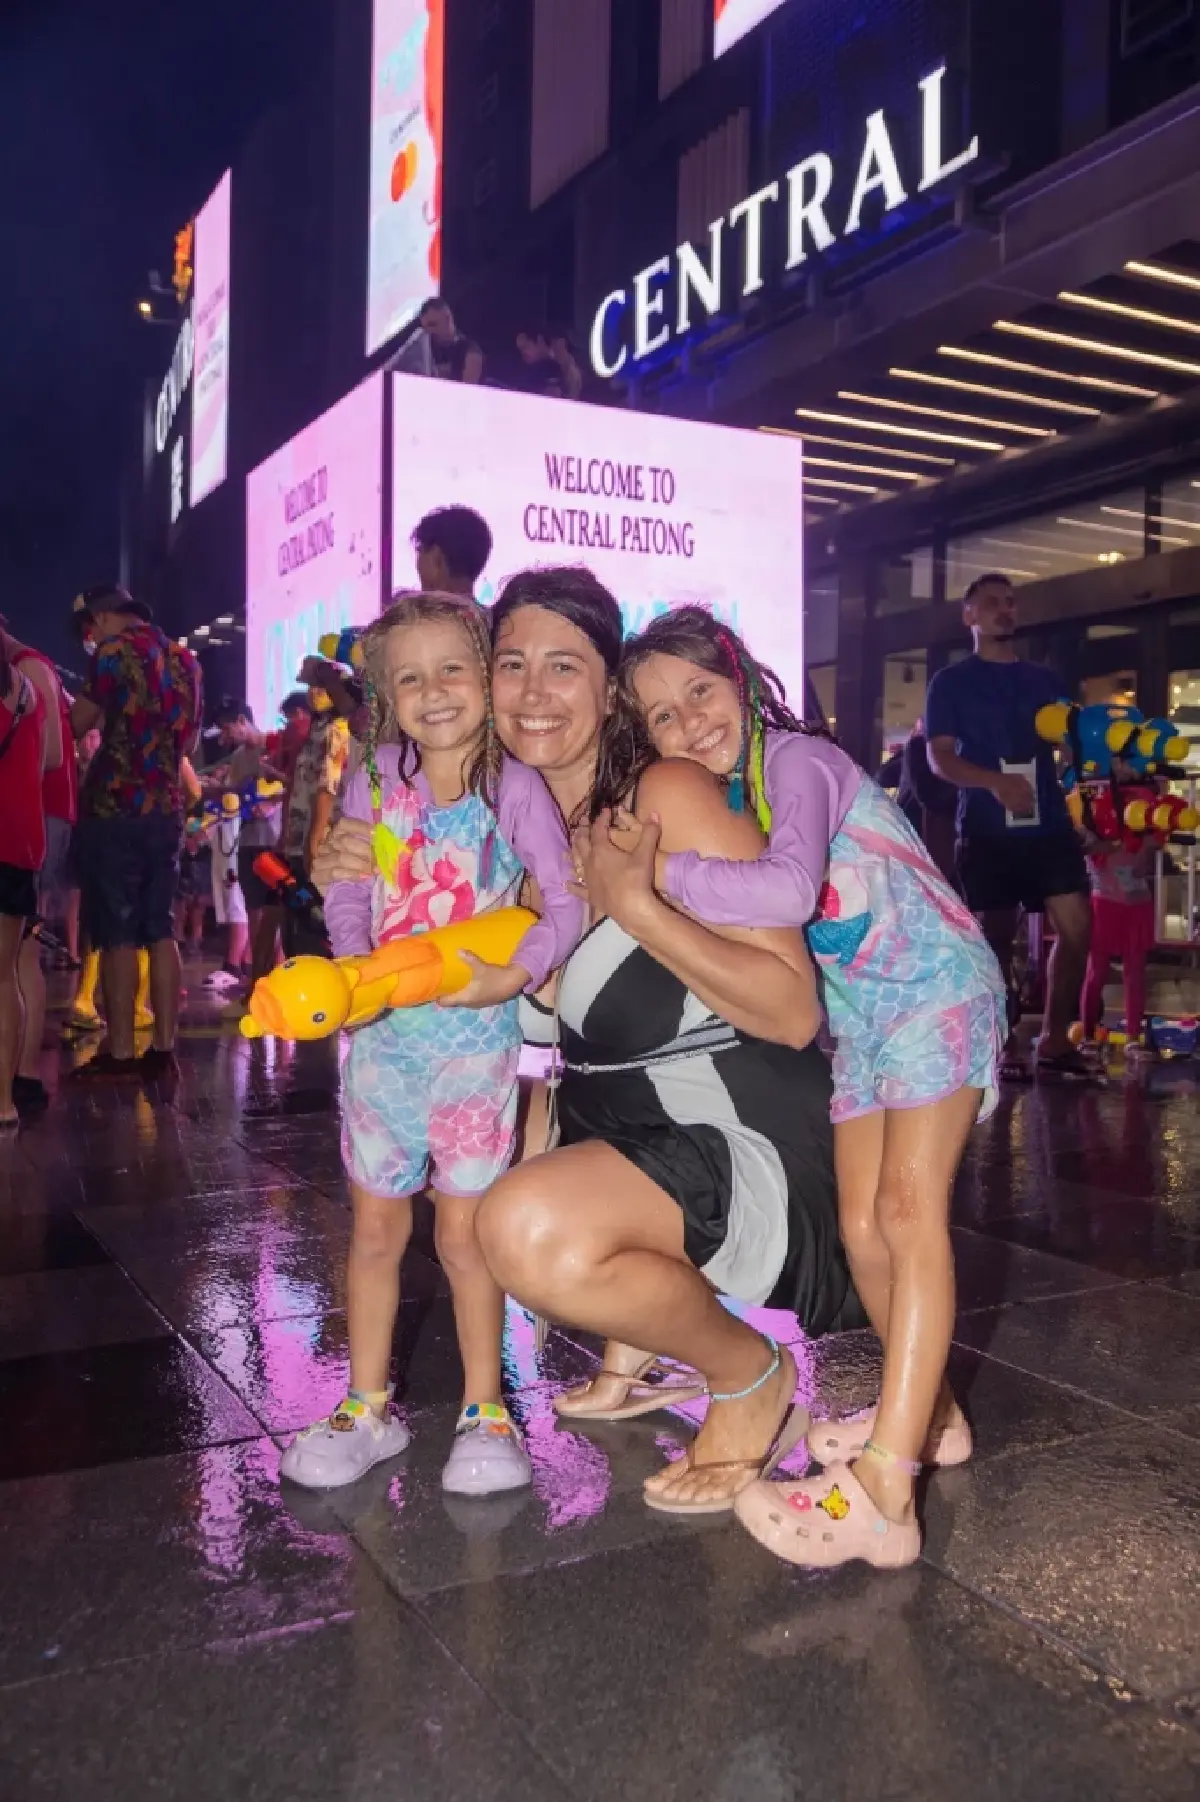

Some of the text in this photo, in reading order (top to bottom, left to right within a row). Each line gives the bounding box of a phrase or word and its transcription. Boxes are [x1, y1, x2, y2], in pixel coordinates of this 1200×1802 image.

[589, 64, 980, 378] CENTRAL
[544, 452, 675, 504] WELCOME TO
[523, 503, 695, 558] CENTRAL PATONG
